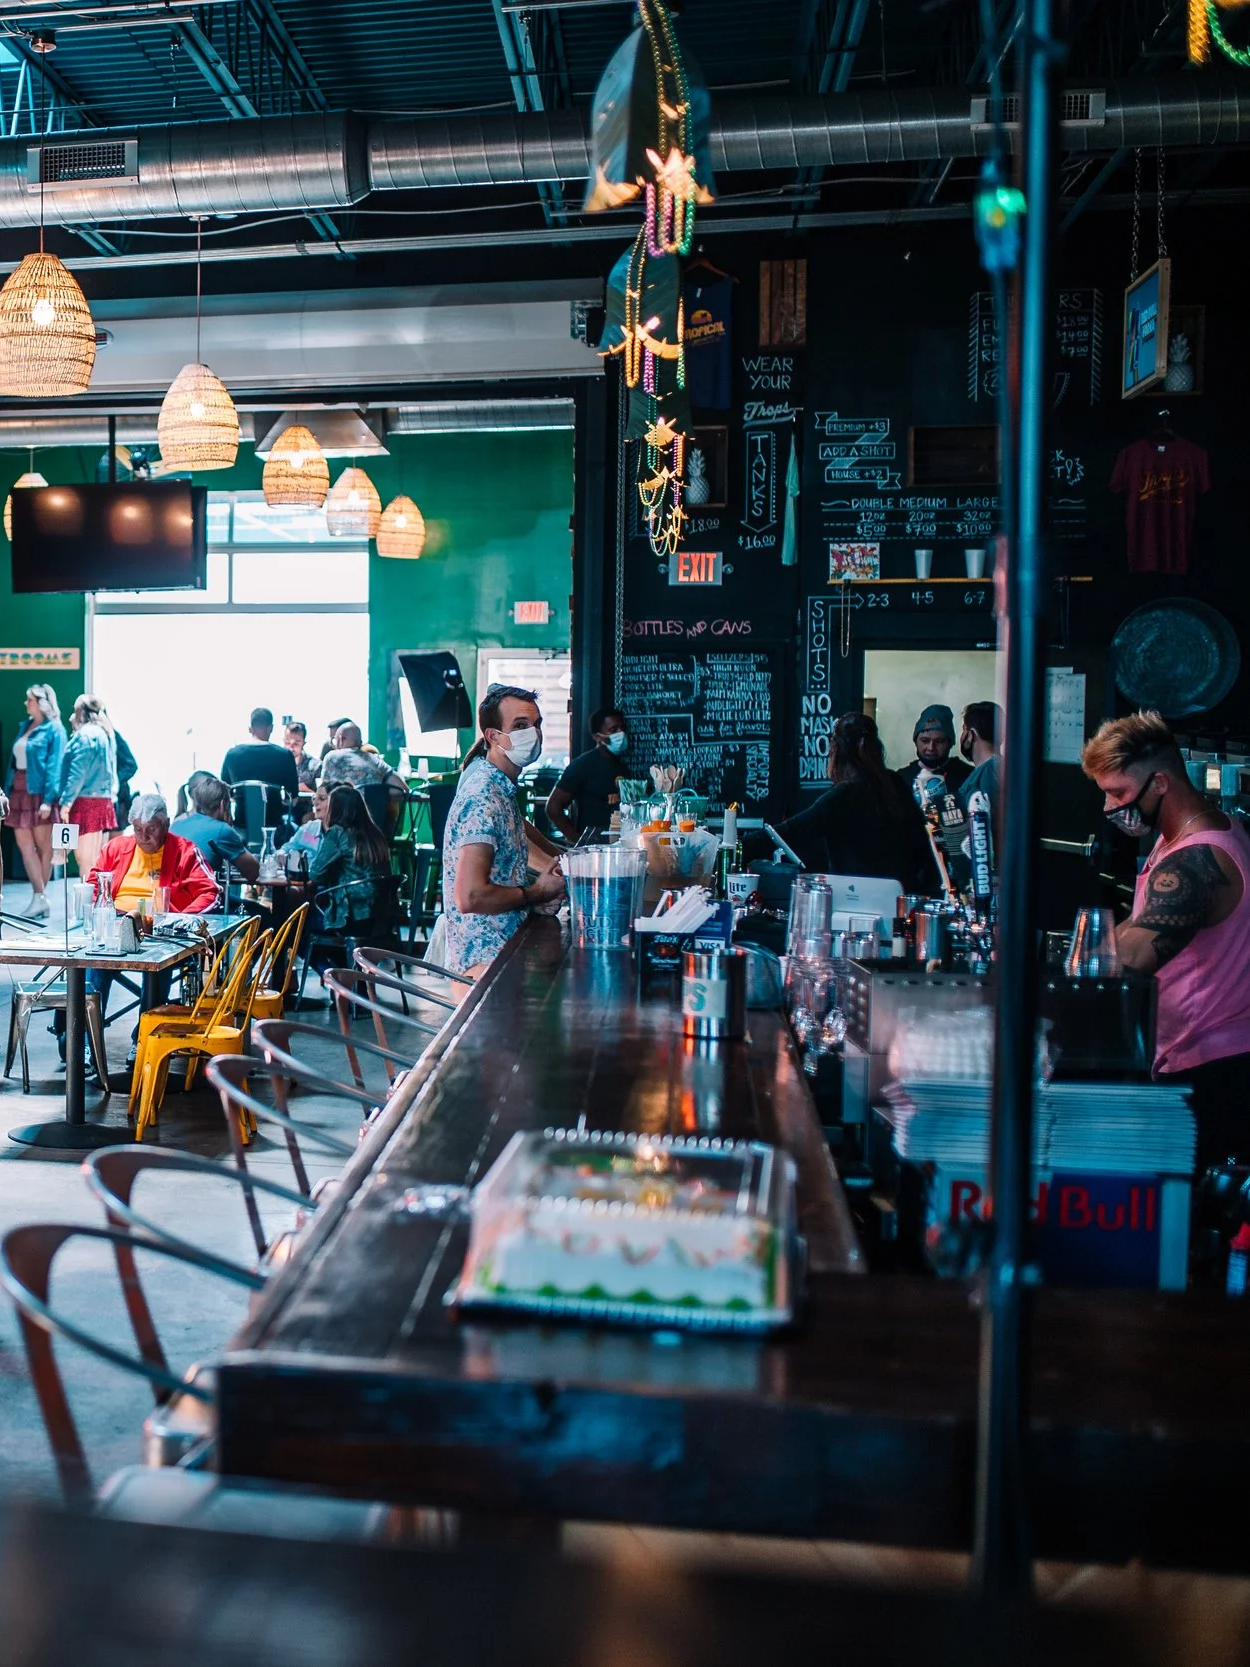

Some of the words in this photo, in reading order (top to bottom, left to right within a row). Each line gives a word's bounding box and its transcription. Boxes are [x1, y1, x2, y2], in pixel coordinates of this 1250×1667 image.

[685, 320, 726, 340] ROPICAL
[742, 356, 793, 372] WEAR
[750, 374, 791, 390] YOUR
[743, 400, 795, 423] Trops
[823, 446, 847, 457] ADD
[849, 446, 859, 457] A
[860, 445, 891, 456] SHOT
[750, 435, 768, 517] TANKS
[831, 470, 861, 480] HOUSE
[851, 498, 894, 509] DOUBLE
[899, 498, 947, 509] MEDIUM
[956, 497, 999, 508] LARGE
[678, 553, 717, 583] EXIT
[520, 602, 544, 622] EXIT
[622, 619, 683, 637] BOTTLES
[686, 621, 707, 639] AND
[710, 619, 752, 635] CANS
[802, 694, 831, 714] NO
[804, 735, 830, 757] NO
[61, 827, 70, 844] 6
[972, 816, 989, 863] LIGHT
[729, 881, 747, 894] Lite
[975, 863, 991, 895] BUD
[699, 942, 721, 950] VISA
[1059, 1186, 1156, 1232] Bull
